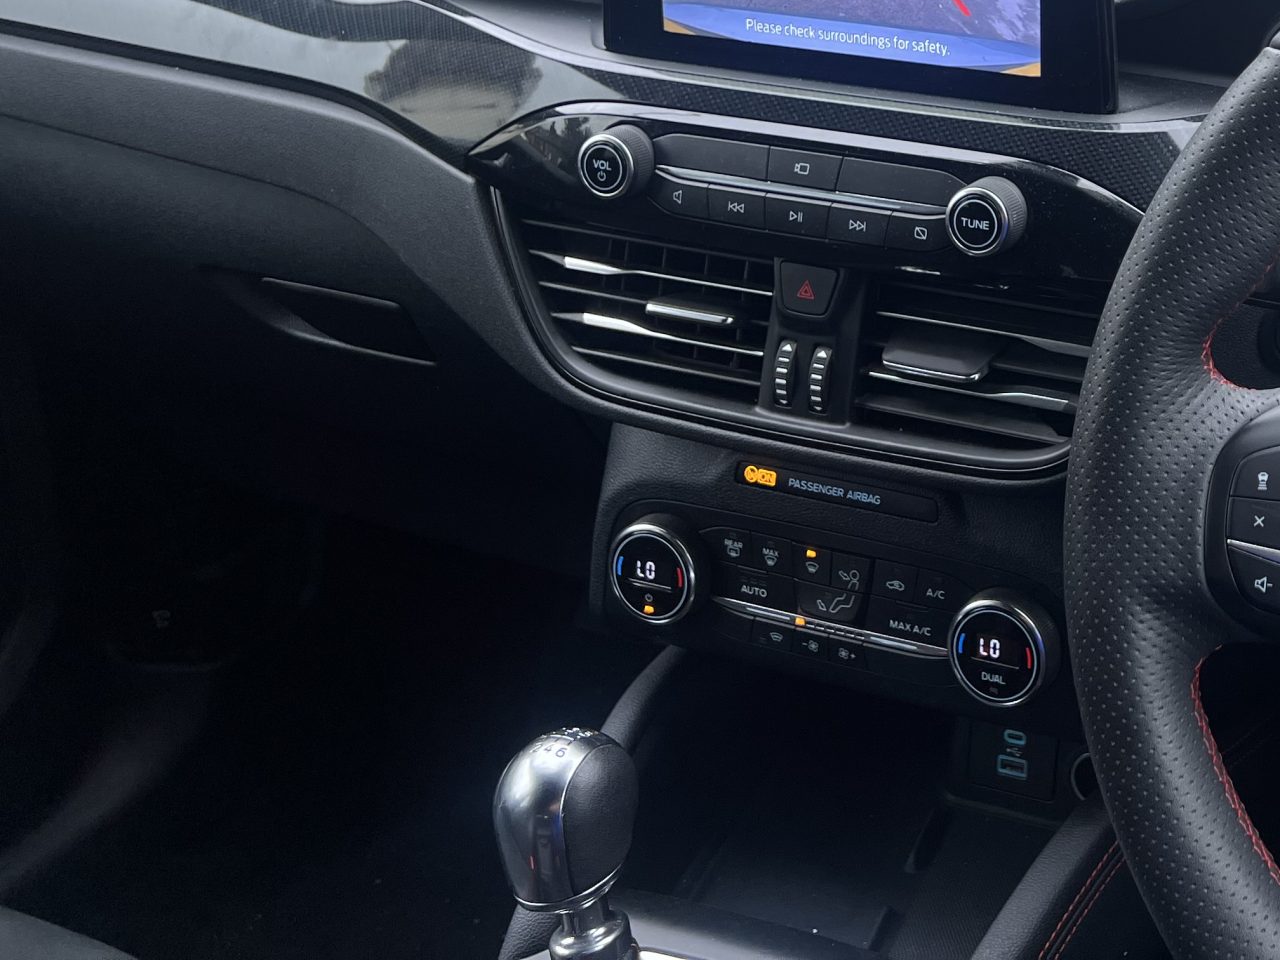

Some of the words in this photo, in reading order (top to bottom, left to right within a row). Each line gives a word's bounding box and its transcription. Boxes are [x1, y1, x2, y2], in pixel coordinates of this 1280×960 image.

[746, 18, 782, 35] Please
[784, 25, 815, 38] check
[818, 30, 891, 49] surroundings
[893, 36, 909, 50] for
[912, 39, 950, 56] safety.
[592, 159, 612, 171] VOL
[961, 217, 990, 231] TUNE
[788, 477, 844, 498] PASSENGER
[846, 490, 881, 505] AIRBAG
[724, 538, 744, 549] REAR
[762, 547, 779, 558] MAX
[741, 583, 768, 598] AUTO
[926, 587, 946, 600] A/C
[889, 618, 912, 633] MAX
[912, 625, 933, 637] A/C
[981, 671, 1006, 686] DUAL
[555, 747, 568, 758] 6
